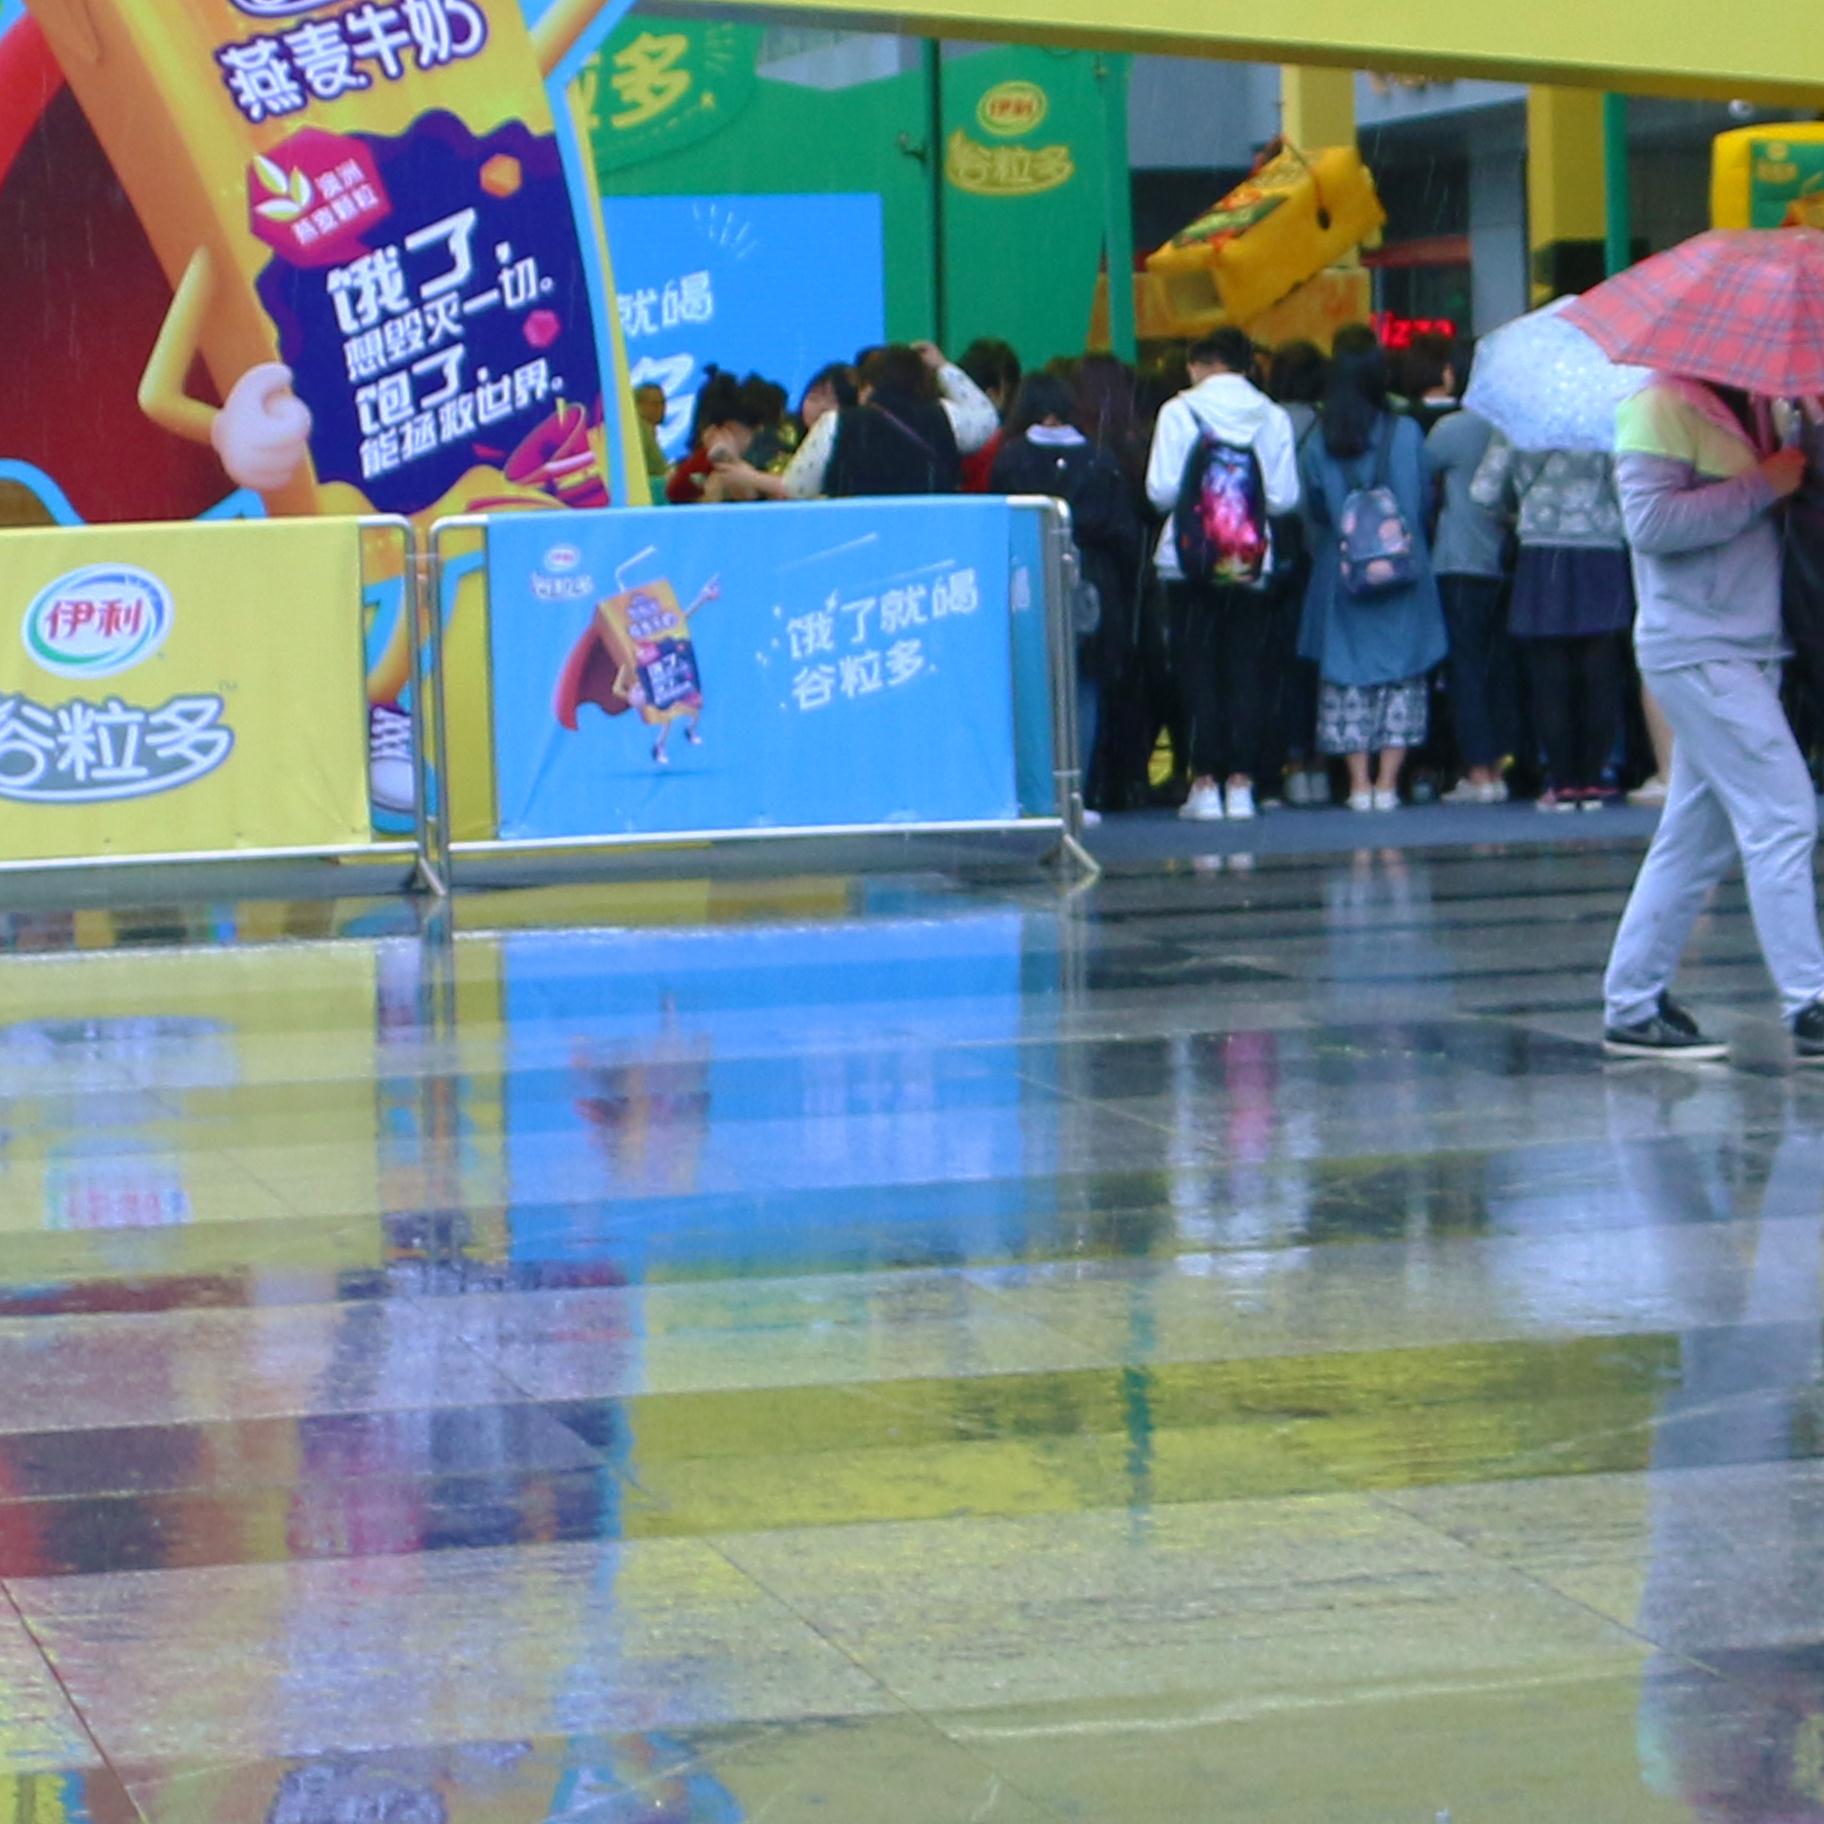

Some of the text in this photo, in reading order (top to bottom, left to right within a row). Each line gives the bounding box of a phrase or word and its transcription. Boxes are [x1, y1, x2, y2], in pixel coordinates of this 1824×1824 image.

[588, 32, 693, 131] 多
[45, 596, 144, 640] 伊利
[787, 567, 979, 660] 饿了就喝
[792, 639, 925, 711] 谷粒多
